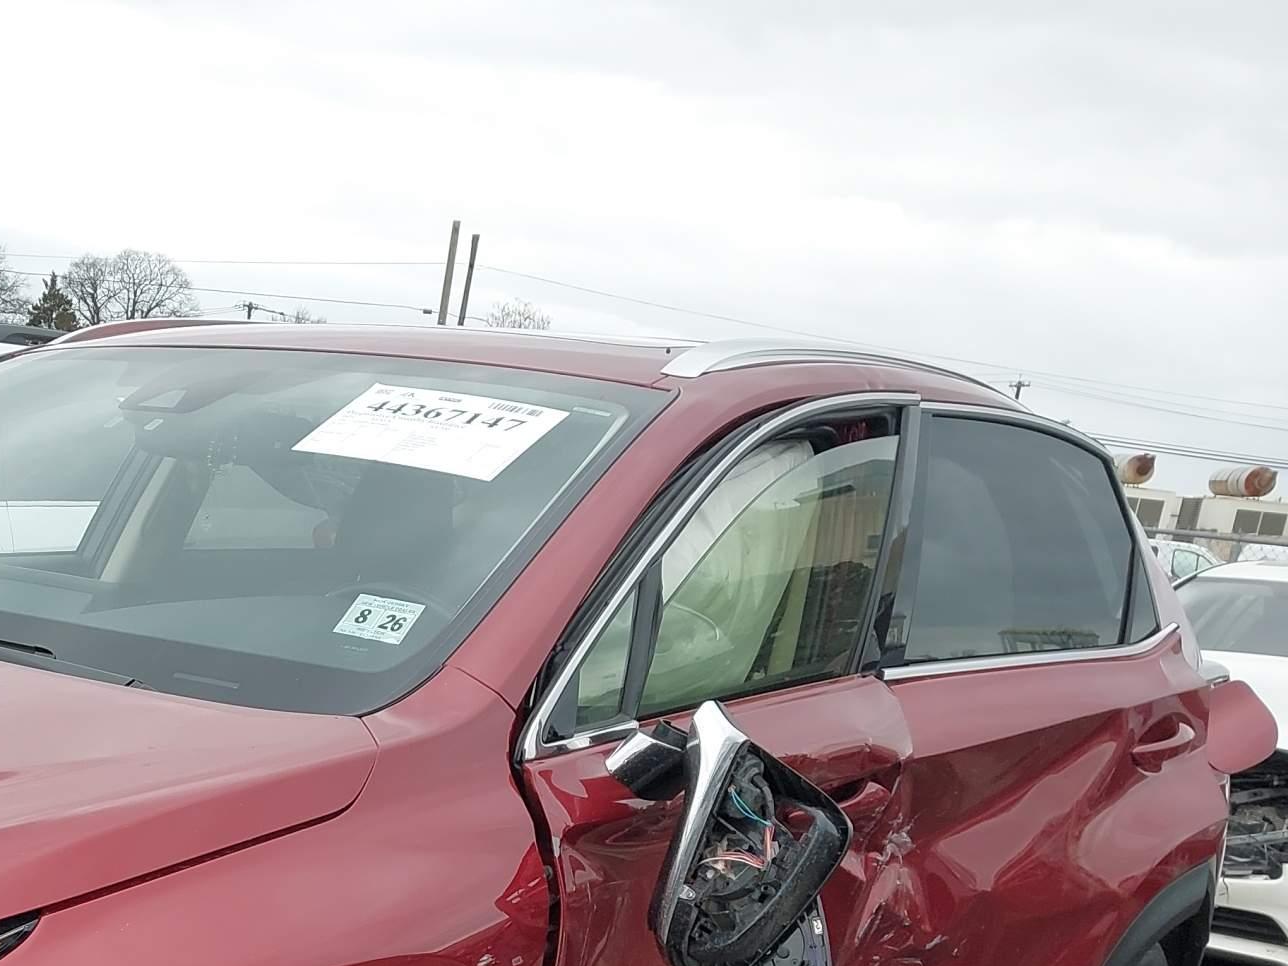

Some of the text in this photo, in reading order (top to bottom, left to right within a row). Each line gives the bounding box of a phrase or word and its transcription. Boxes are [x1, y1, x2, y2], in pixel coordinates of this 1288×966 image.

[366, 400, 528, 432] 44367147
[354, 608, 407, 632] 8 26
